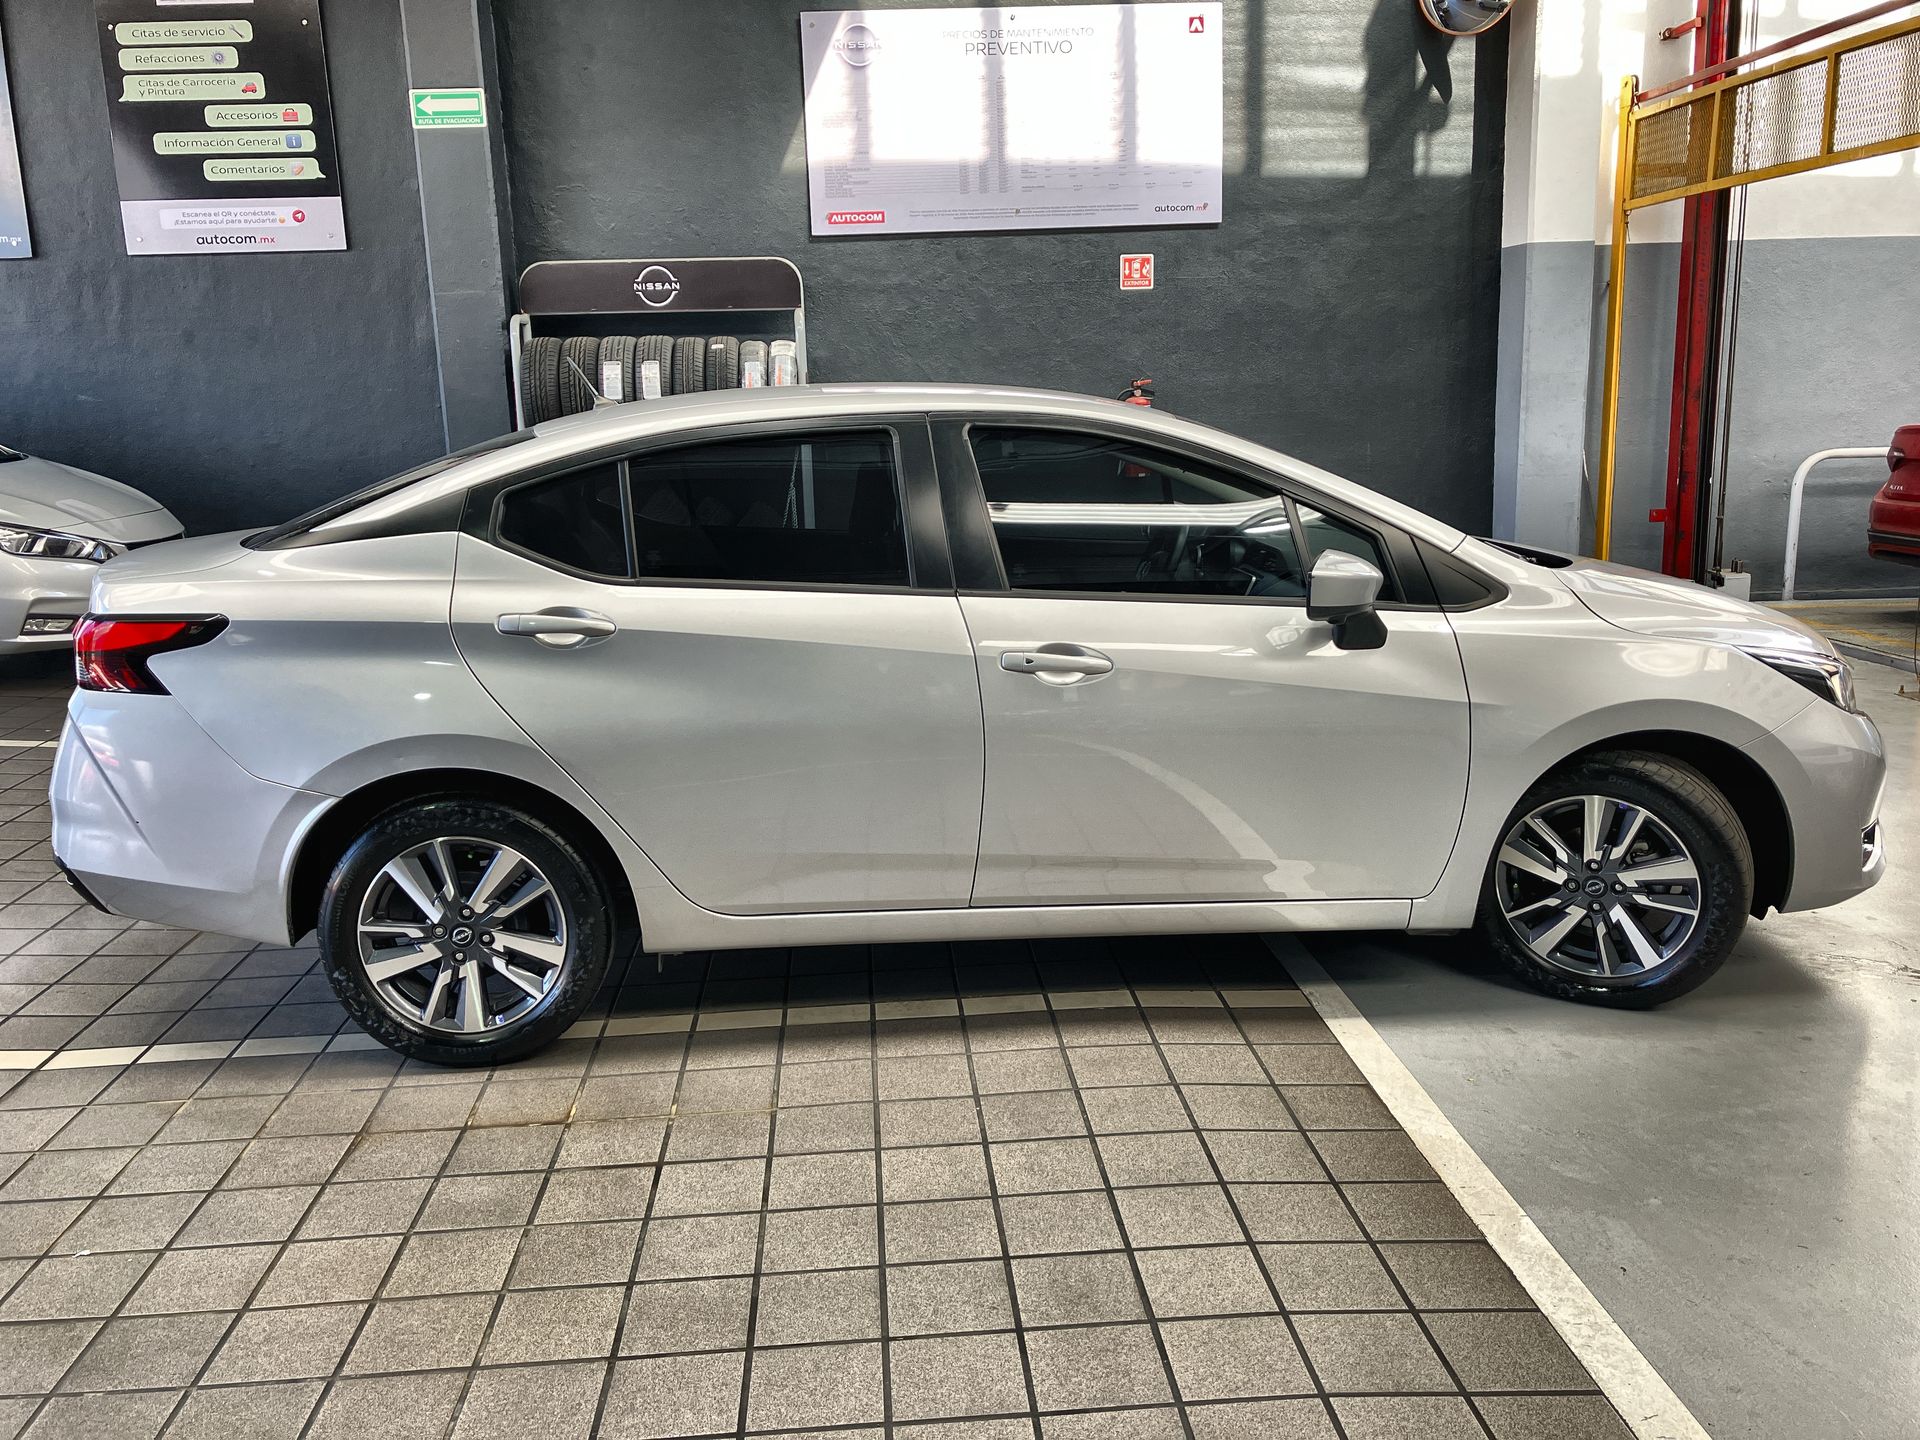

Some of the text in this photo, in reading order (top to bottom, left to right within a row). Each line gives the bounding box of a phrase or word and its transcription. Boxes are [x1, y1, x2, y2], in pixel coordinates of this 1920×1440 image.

[131, 27, 225, 38] Citas de servicio
[942, 27, 1095, 39] PRECIOS DE MANTENIMIENTO
[965, 40, 1073, 56] PREVENTIVO
[135, 54, 205, 64] Refacciones
[138, 79, 164, 87] Citas
[147, 88, 185, 96] Pintura
[216, 111, 278, 120] Accesorios
[164, 137, 281, 148] Información General
[210, 165, 285, 174] Comentarios
[831, 211, 883, 222] AUTOCOM
[196, 234, 276, 245] autocom.mx
[633, 282, 680, 290] NISSAN
